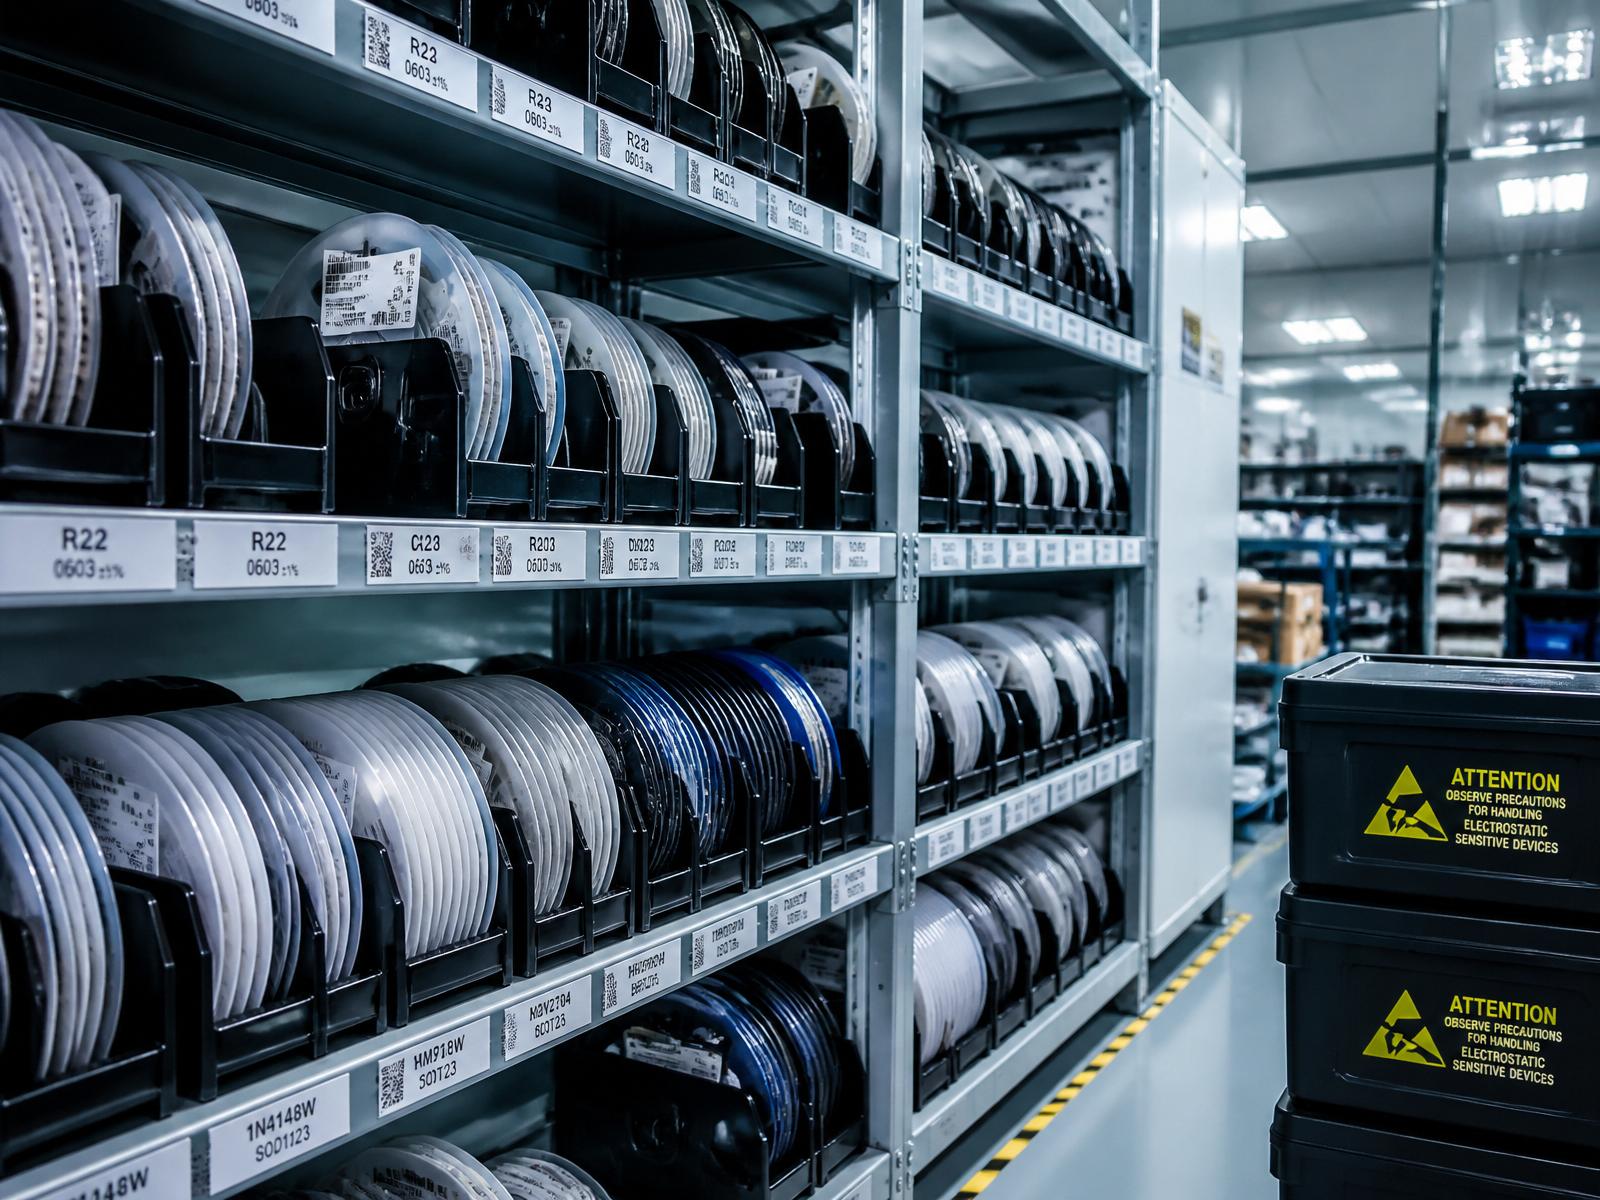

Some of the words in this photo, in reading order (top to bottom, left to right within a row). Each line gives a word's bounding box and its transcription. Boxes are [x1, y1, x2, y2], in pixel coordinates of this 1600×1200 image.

[404, 59, 431, 83] 0603
[525, 109, 547, 131] 0603
[62, 526, 108, 551] R22
[252, 531, 287, 551] R22
[53, 558, 96, 579] 0603
[247, 558, 279, 576] 0603
[1451, 767, 1560, 793] ATTENTION
[1446, 789, 1493, 804] OBSERVE
[1495, 793, 1566, 809] PRECAUTIONS
[1468, 804, 1488, 817] FOR
[1491, 806, 1543, 821] HANDLING
[1464, 819, 1548, 837] ELECTROSTATIC
[1455, 833, 1510, 849] SENSITIVE
[1512, 838, 1559, 854] DEVICES
[1449, 995, 1557, 1026] ATTENTION
[1444, 1016, 1491, 1033] OBSERVE
[1494, 1022, 1563, 1043] PRECAUTIONS
[414, 1034, 465, 1070] HM918W
[1467, 1032, 1487, 1045] FOR
[1490, 1036, 1541, 1053] HANDLING
[1461, 1046, 1546, 1069] ELECTROSTATIC
[1452, 1059, 1506, 1078] SENSITIVE
[1509, 1067, 1555, 1086] DEVICES
[247, 1097, 317, 1142] 1N4148W
